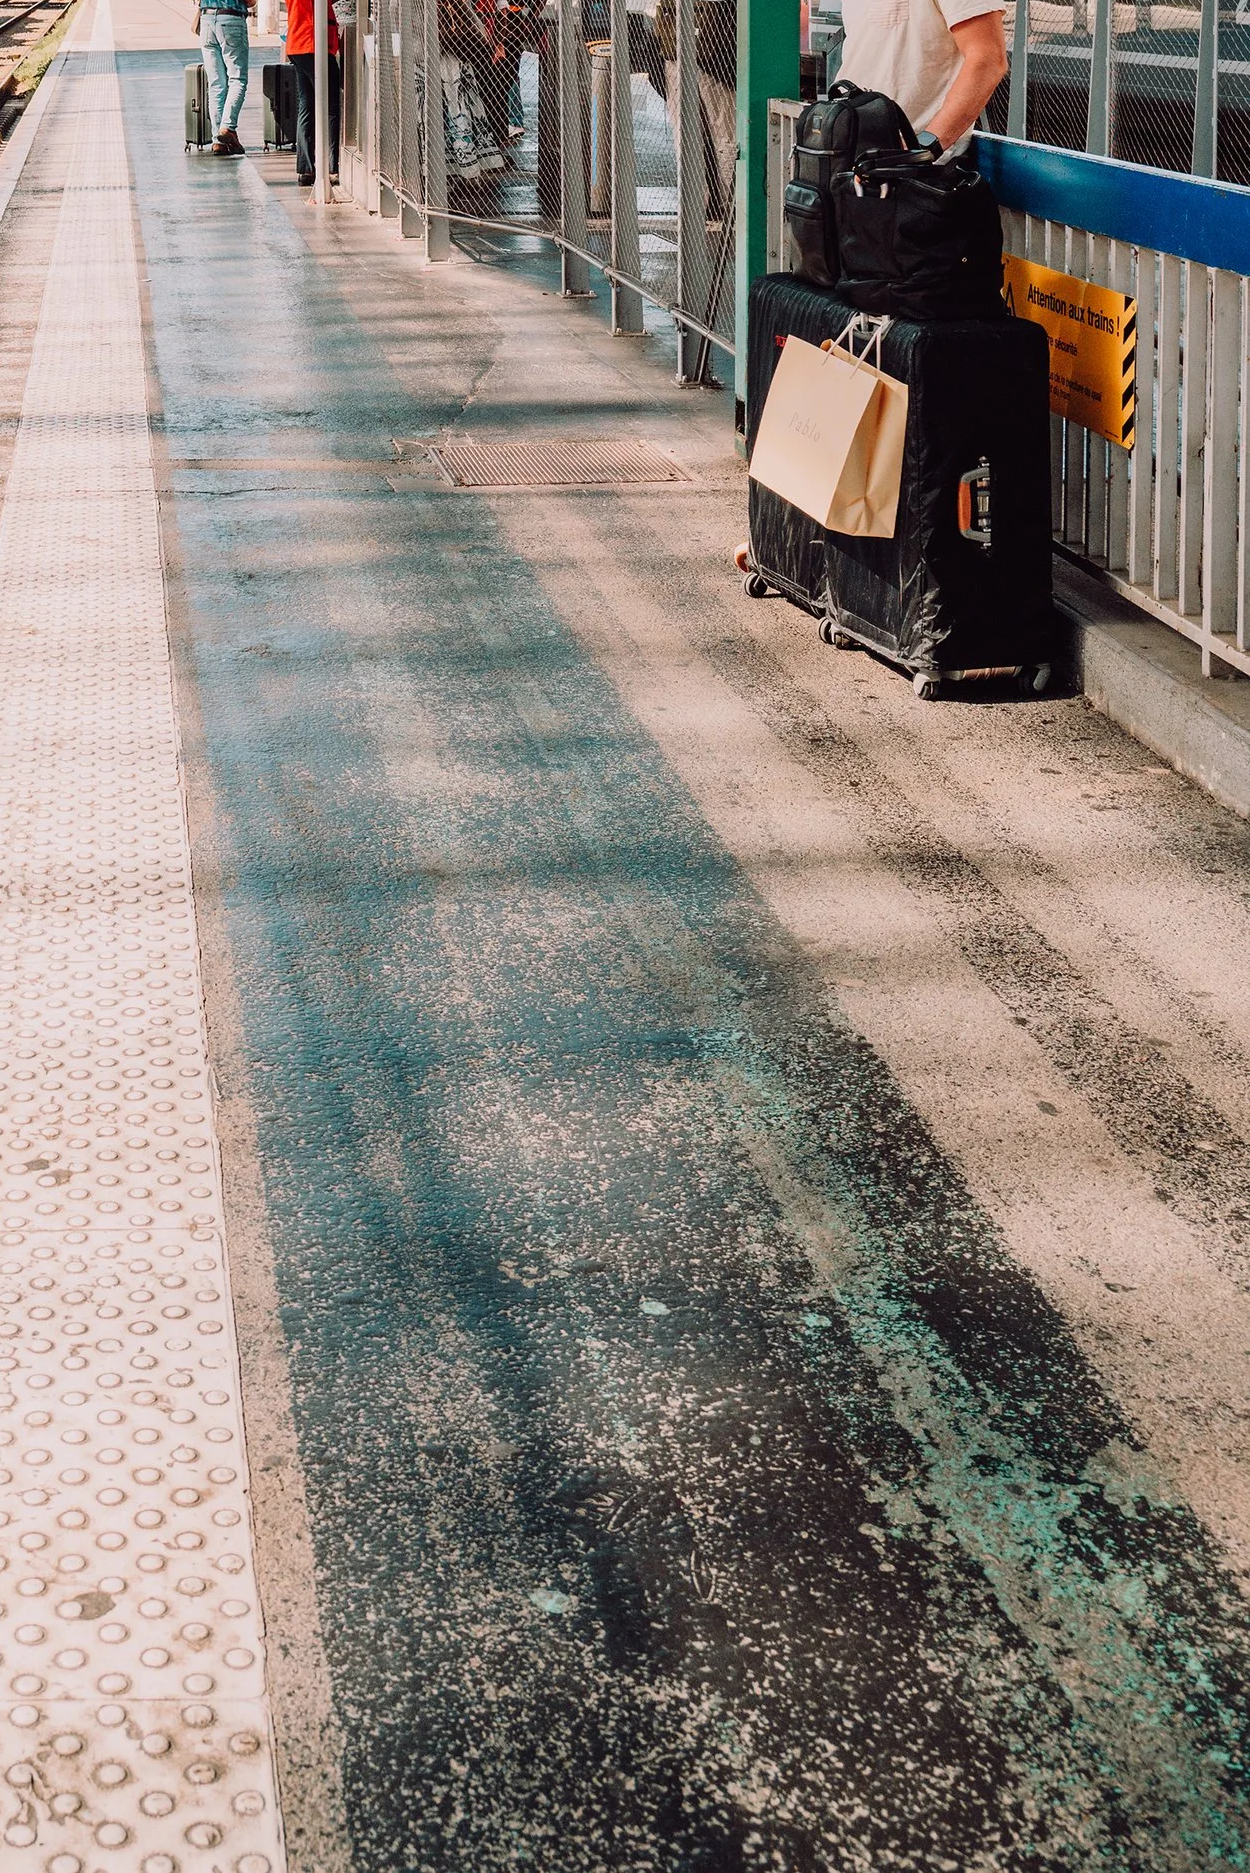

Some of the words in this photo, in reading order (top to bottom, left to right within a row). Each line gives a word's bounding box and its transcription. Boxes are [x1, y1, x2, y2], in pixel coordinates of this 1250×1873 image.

[1027, 283, 1067, 317] Attention
[1068, 303, 1086, 325] aux
[1087, 309, 1115, 335] trains
[789, 411, 821, 443] Pablo
